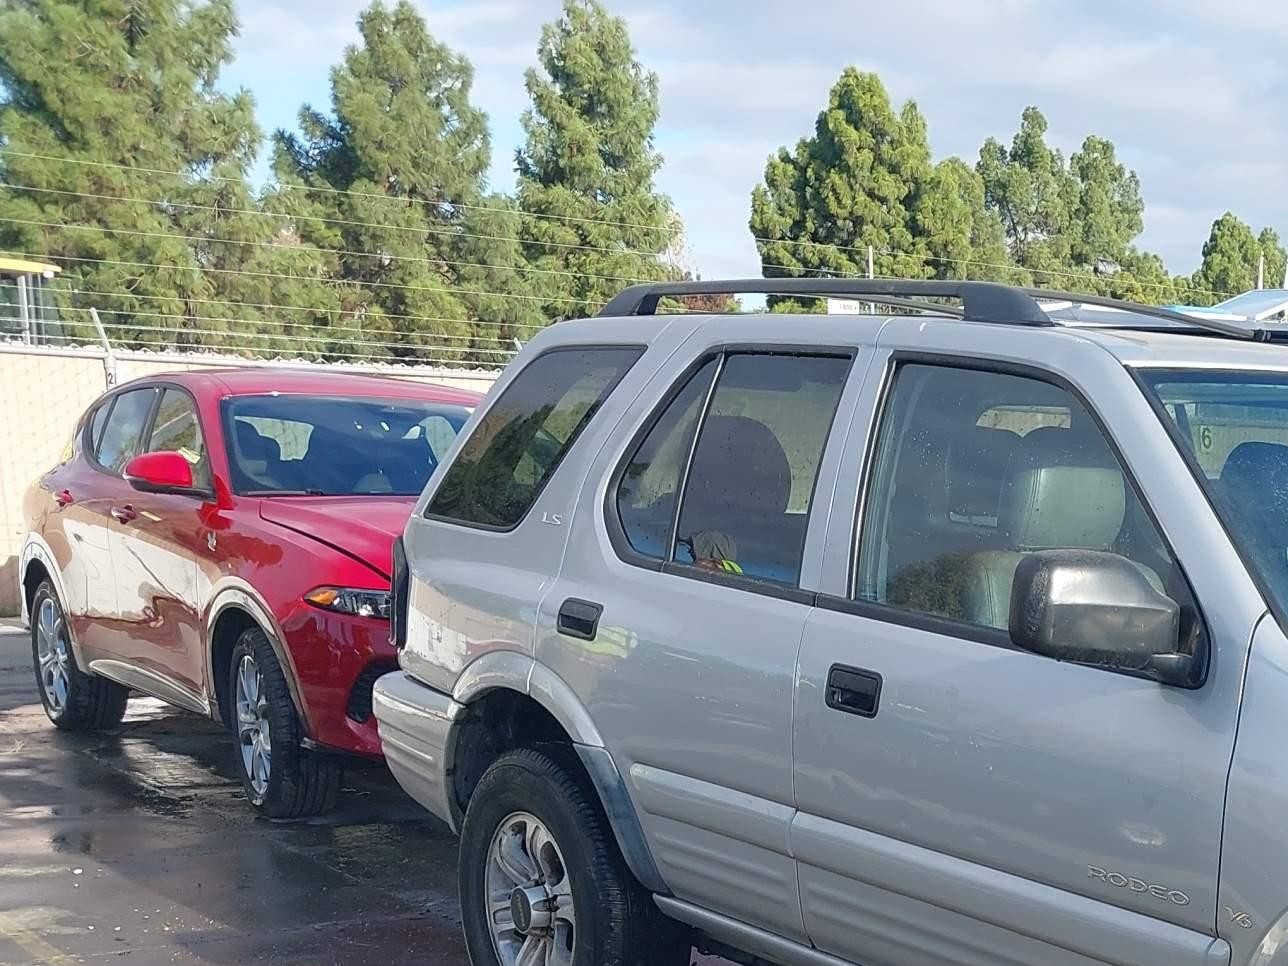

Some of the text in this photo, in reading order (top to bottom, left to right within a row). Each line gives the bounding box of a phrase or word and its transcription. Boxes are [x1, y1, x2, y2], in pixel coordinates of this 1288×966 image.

[107, 372, 114, 385] 2
[1202, 427, 1212, 449] 6
[541, 511, 562, 525] LS
[1087, 864, 1191, 905] RODEO
[1225, 906, 1254, 929] V6
